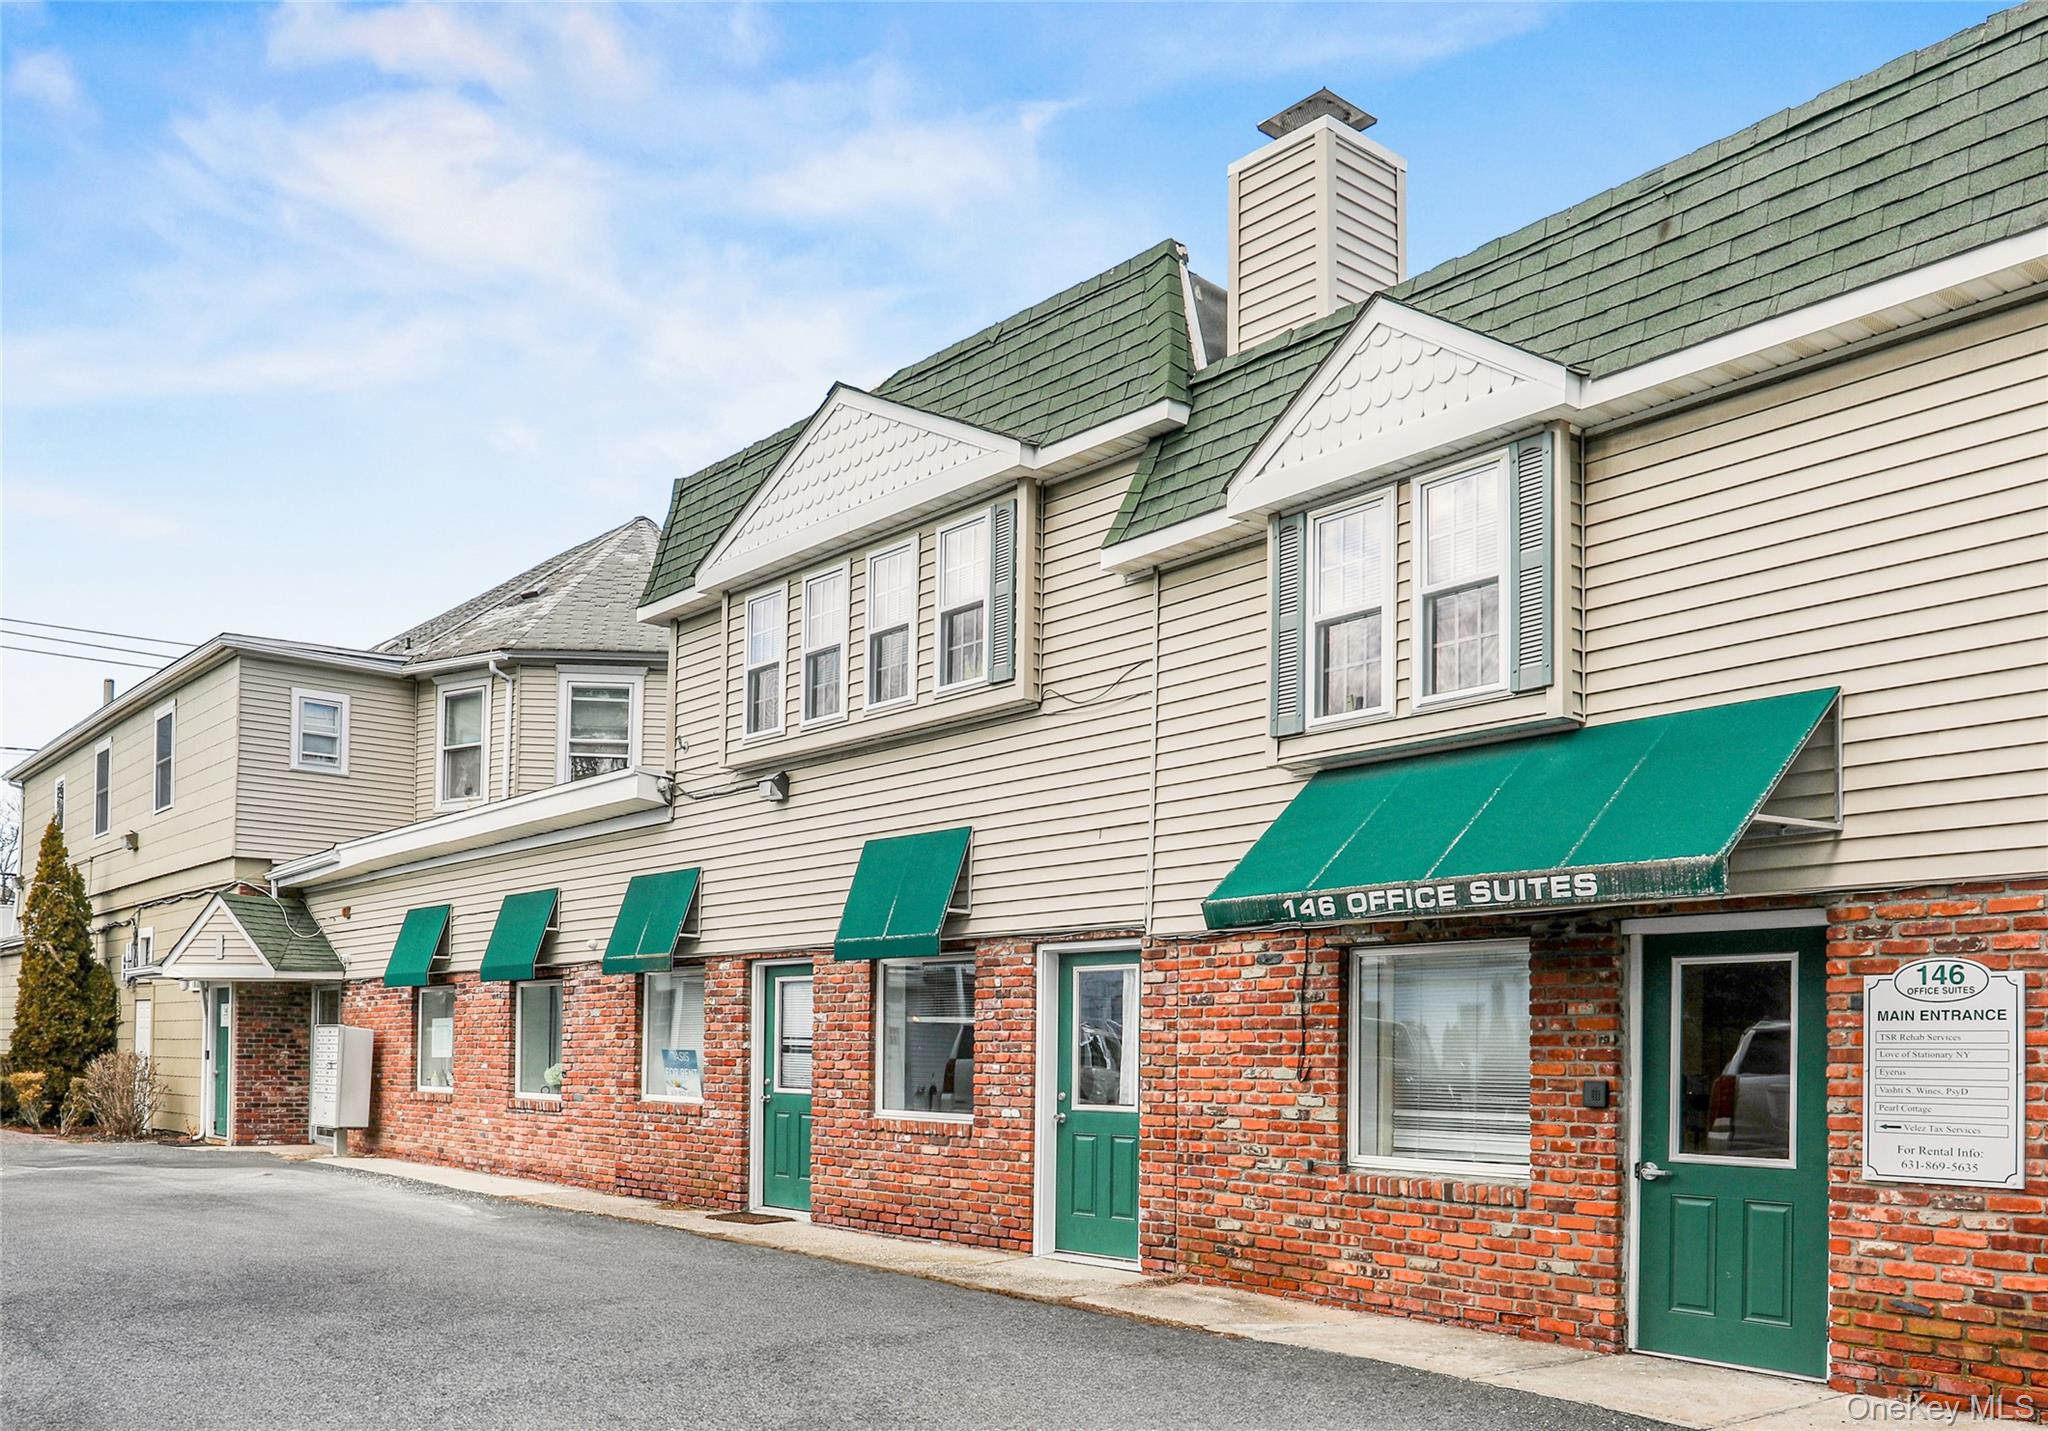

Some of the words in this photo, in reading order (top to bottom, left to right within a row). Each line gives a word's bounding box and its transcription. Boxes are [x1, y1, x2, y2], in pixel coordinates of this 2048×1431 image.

[1282, 896, 1336, 918] 146
[1346, 885, 1457, 914] OFFICE
[1469, 873, 1598, 903] SUITES
[1917, 964, 1965, 985] 146
[1907, 987, 1939, 996] OFFICE
[1942, 986, 1976, 994] SUITES
[1877, 1010, 1915, 1022] MAIN
[1920, 1009, 2007, 1021] ENTRANCE
[1912, 1051, 1953, 1060] Stationary
[1956, 1051, 1970, 1059] NY
[1879, 1086, 1904, 1094] Vashti
[1946, 1088, 1969, 1097] PsyD
[1901, 1104, 1932, 1113] Cottage
[1904, 1124, 1926, 1132] Velez
[1928, 1125, 1944, 1133] Tax
[1946, 1126, 1982, 1134] Services
[1897, 1145, 1915, 1154] For
[1919, 1146, 1953, 1156] Rental
[1957, 1148, 1984, 1158] Info:
[1901, 1160, 1979, 1173] 631-869-5635
